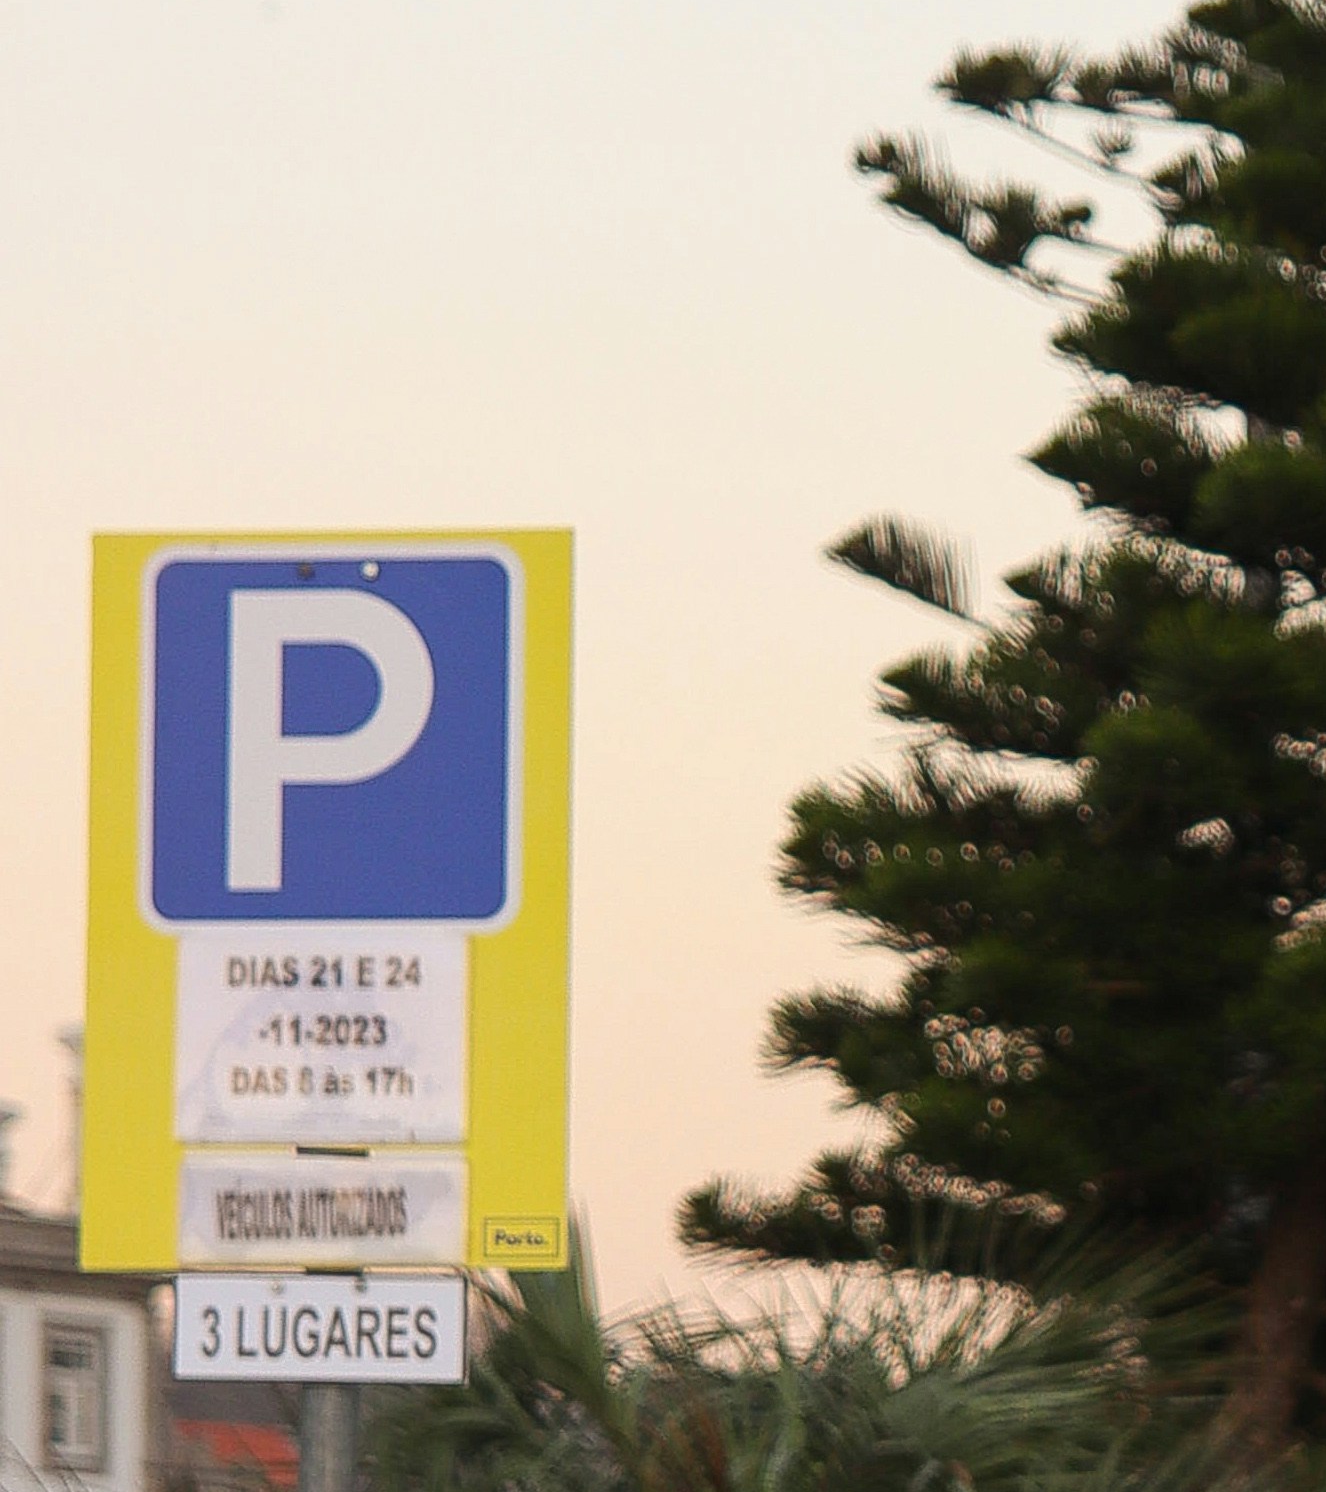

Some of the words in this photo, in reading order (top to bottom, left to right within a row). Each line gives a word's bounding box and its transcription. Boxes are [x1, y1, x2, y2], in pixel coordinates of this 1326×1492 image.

[225, 588, 435, 892] P
[229, 956, 299, 988] DIAS
[311, 956, 343, 988] 21
[357, 956, 376, 988] E
[386, 956, 421, 988] 24
[259, 1014, 388, 1047] -11-2023
[231, 1066, 288, 1096] DAS
[366, 1066, 414, 1096] 17h
[201, 1307, 221, 1358] 3
[237, 1307, 438, 1358] LUGARES
